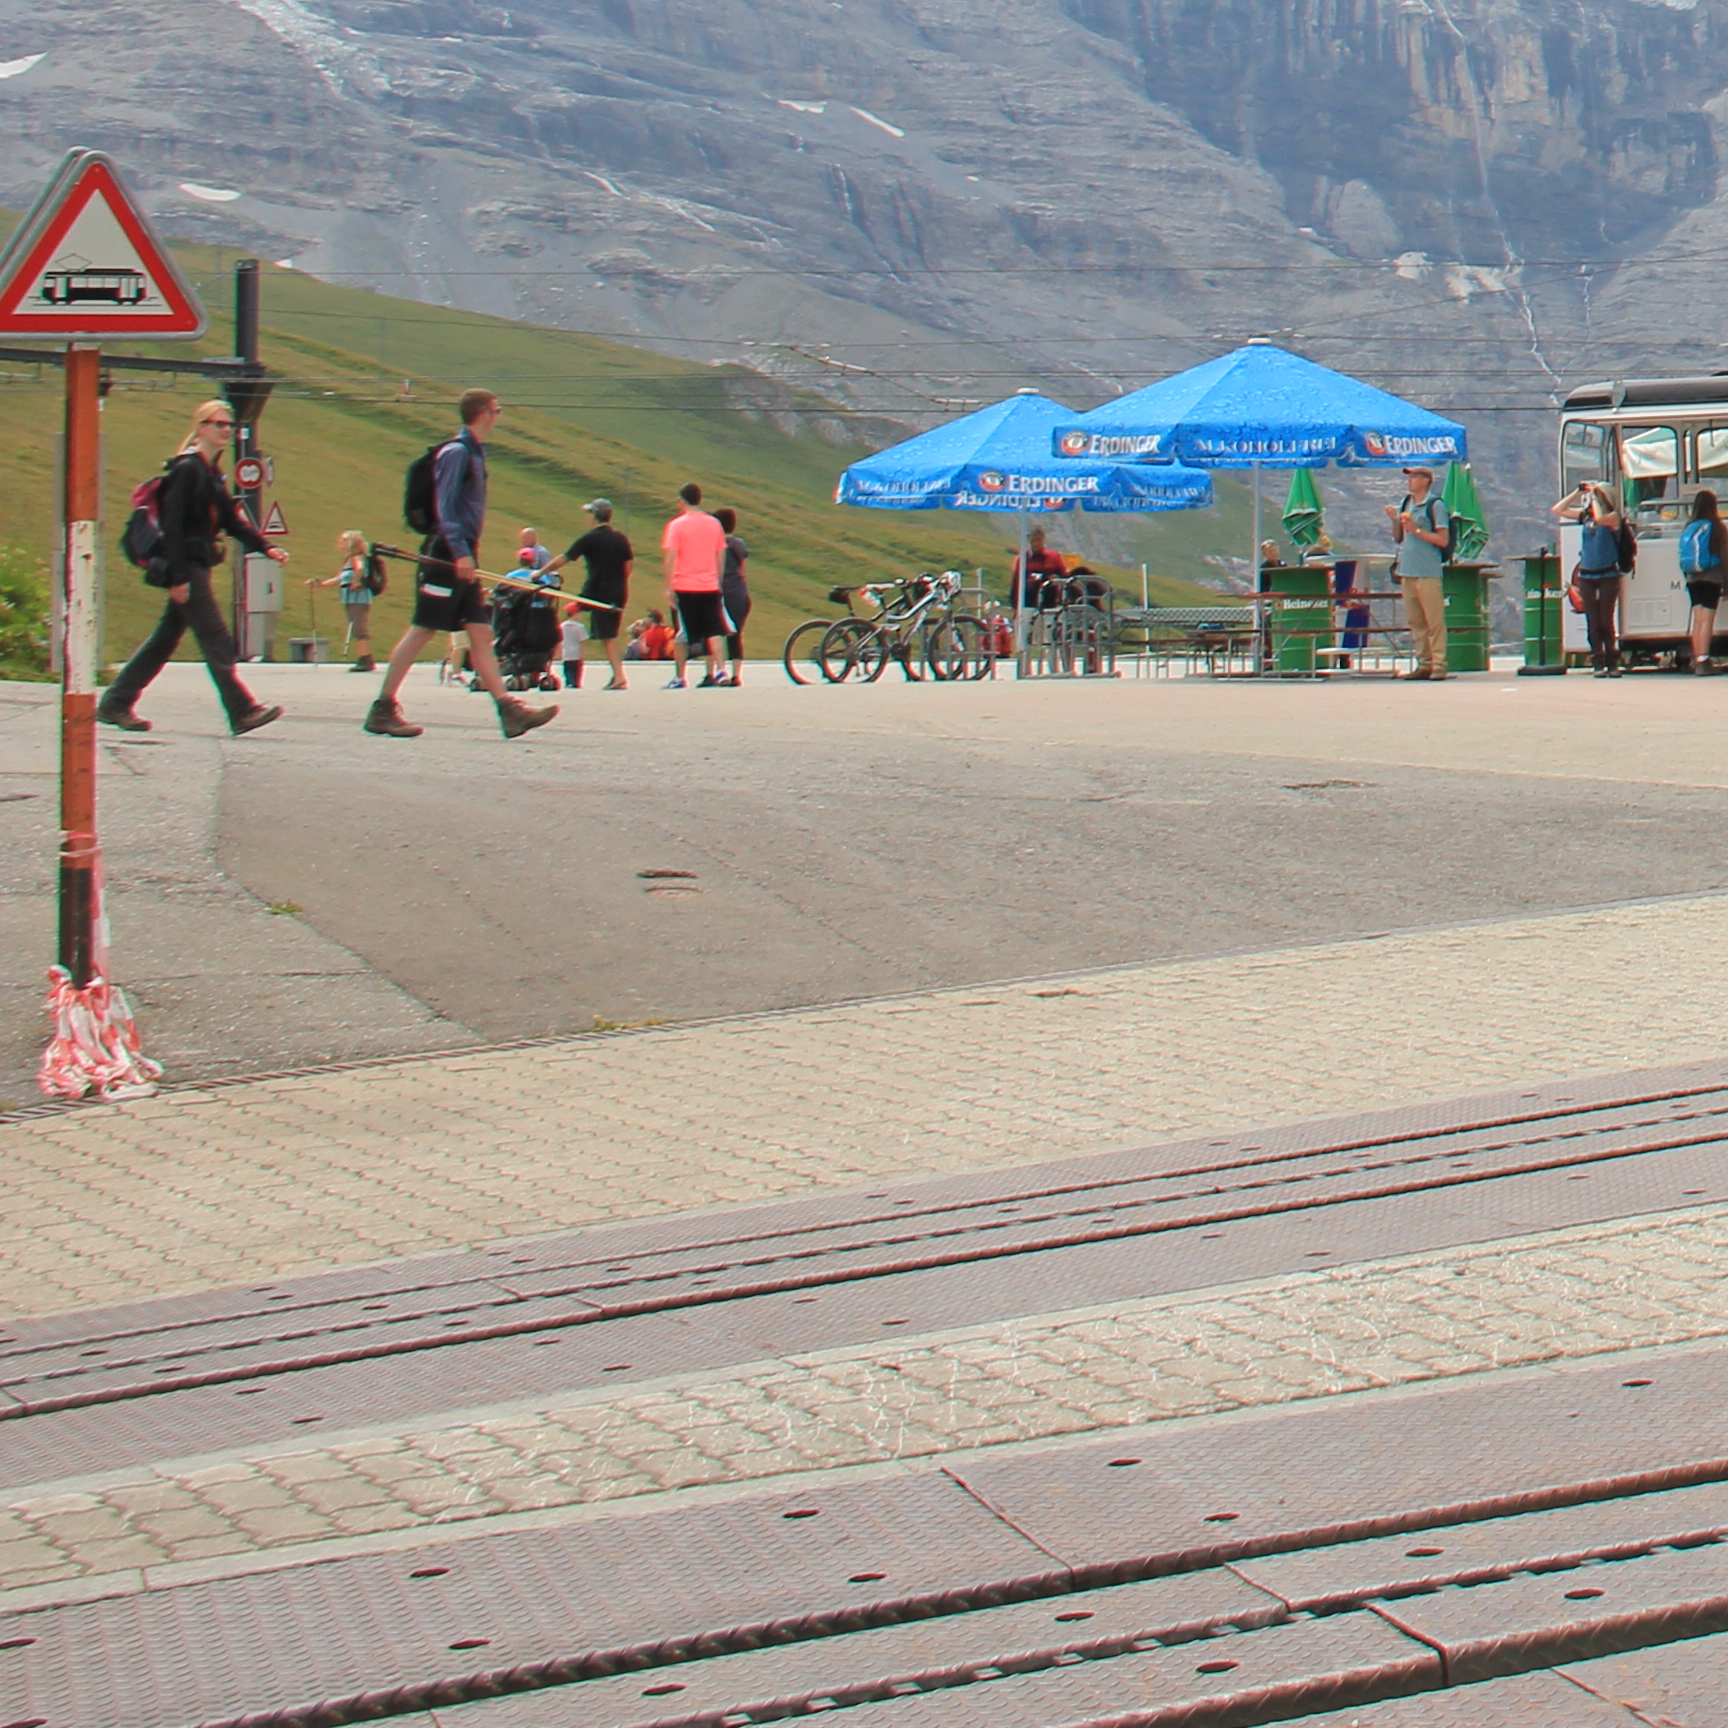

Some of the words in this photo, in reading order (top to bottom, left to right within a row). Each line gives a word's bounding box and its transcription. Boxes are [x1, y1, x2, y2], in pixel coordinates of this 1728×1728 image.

[1089, 434, 1161, 456] ERDINGER
[1384, 434, 1458, 455] ERDINGER
[1007, 473, 1100, 494] ERDINGER
